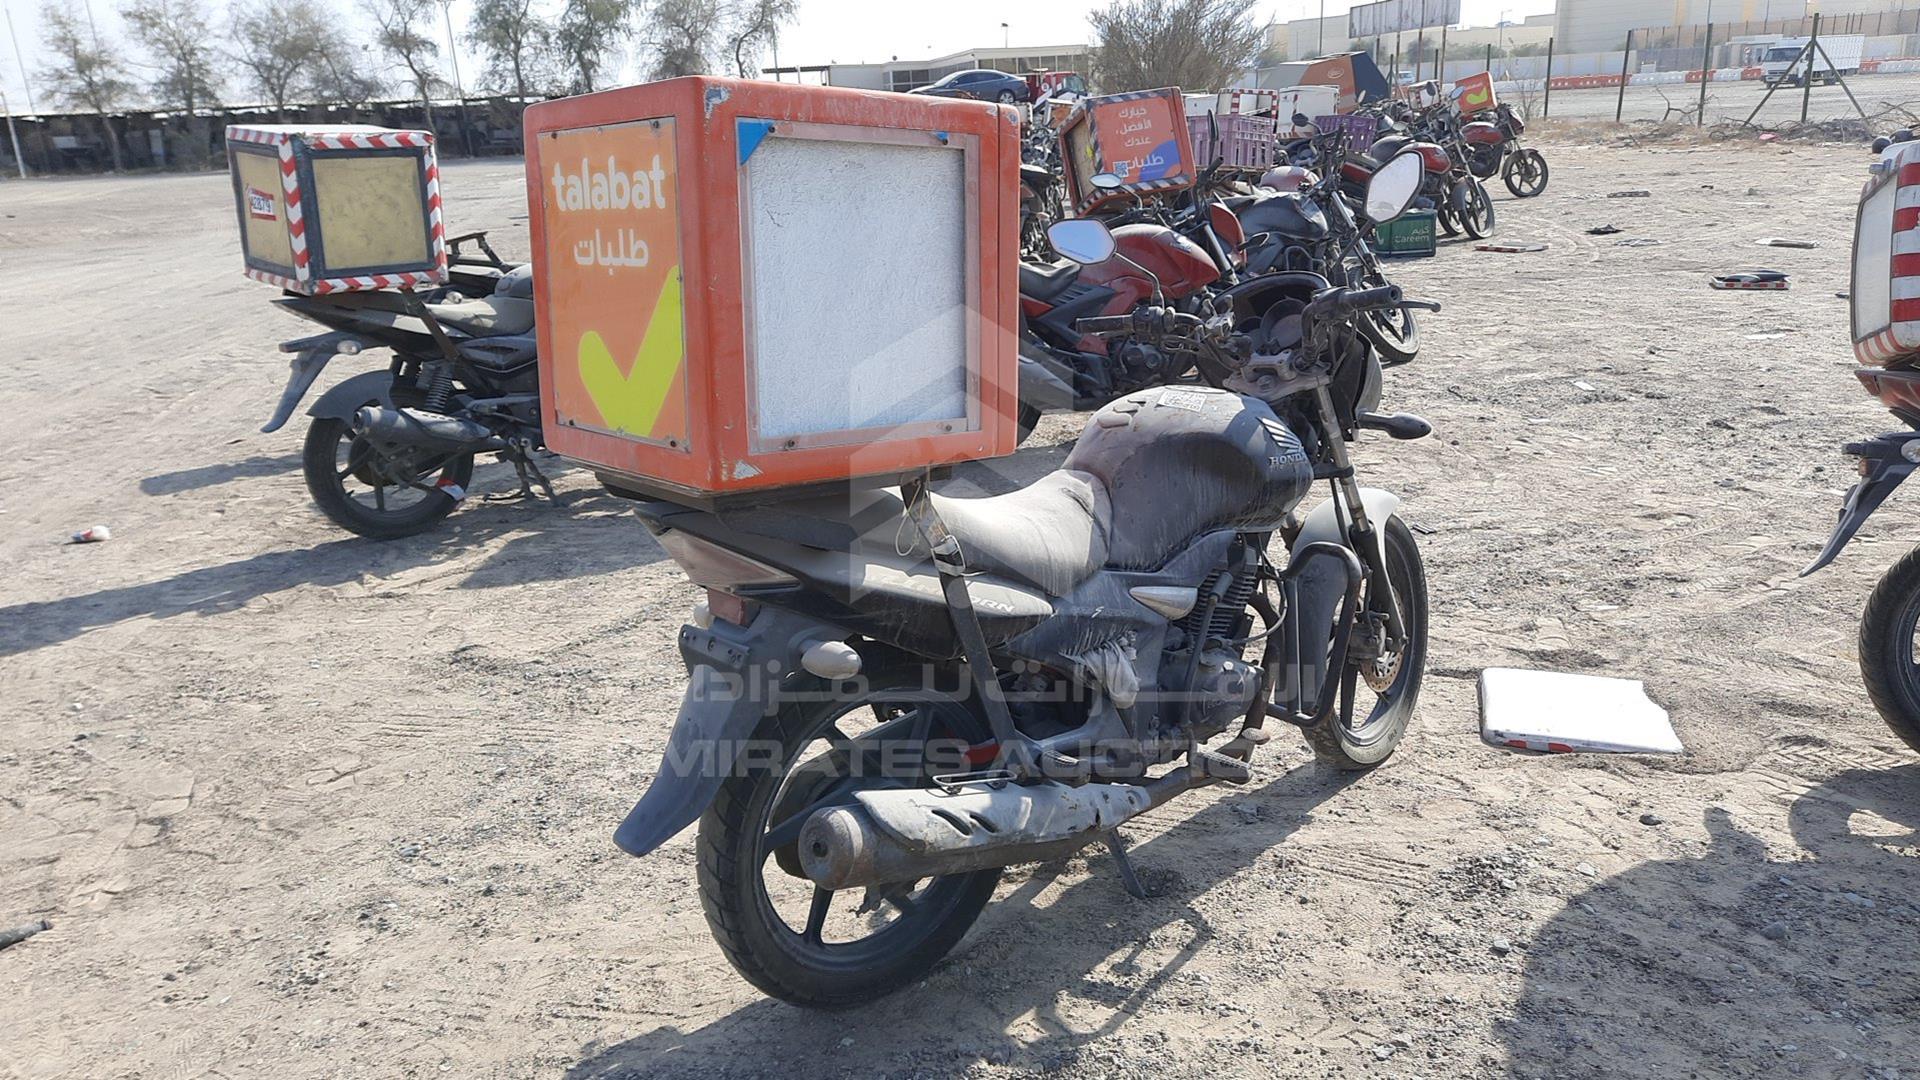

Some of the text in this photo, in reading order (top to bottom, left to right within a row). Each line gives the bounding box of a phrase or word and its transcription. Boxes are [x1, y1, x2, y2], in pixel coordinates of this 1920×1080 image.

[1124, 135, 1152, 147] عندك
[551, 153, 666, 212] talabat
[573, 228, 649, 276] طلبات
[1268, 452, 1308, 466] HONDA
